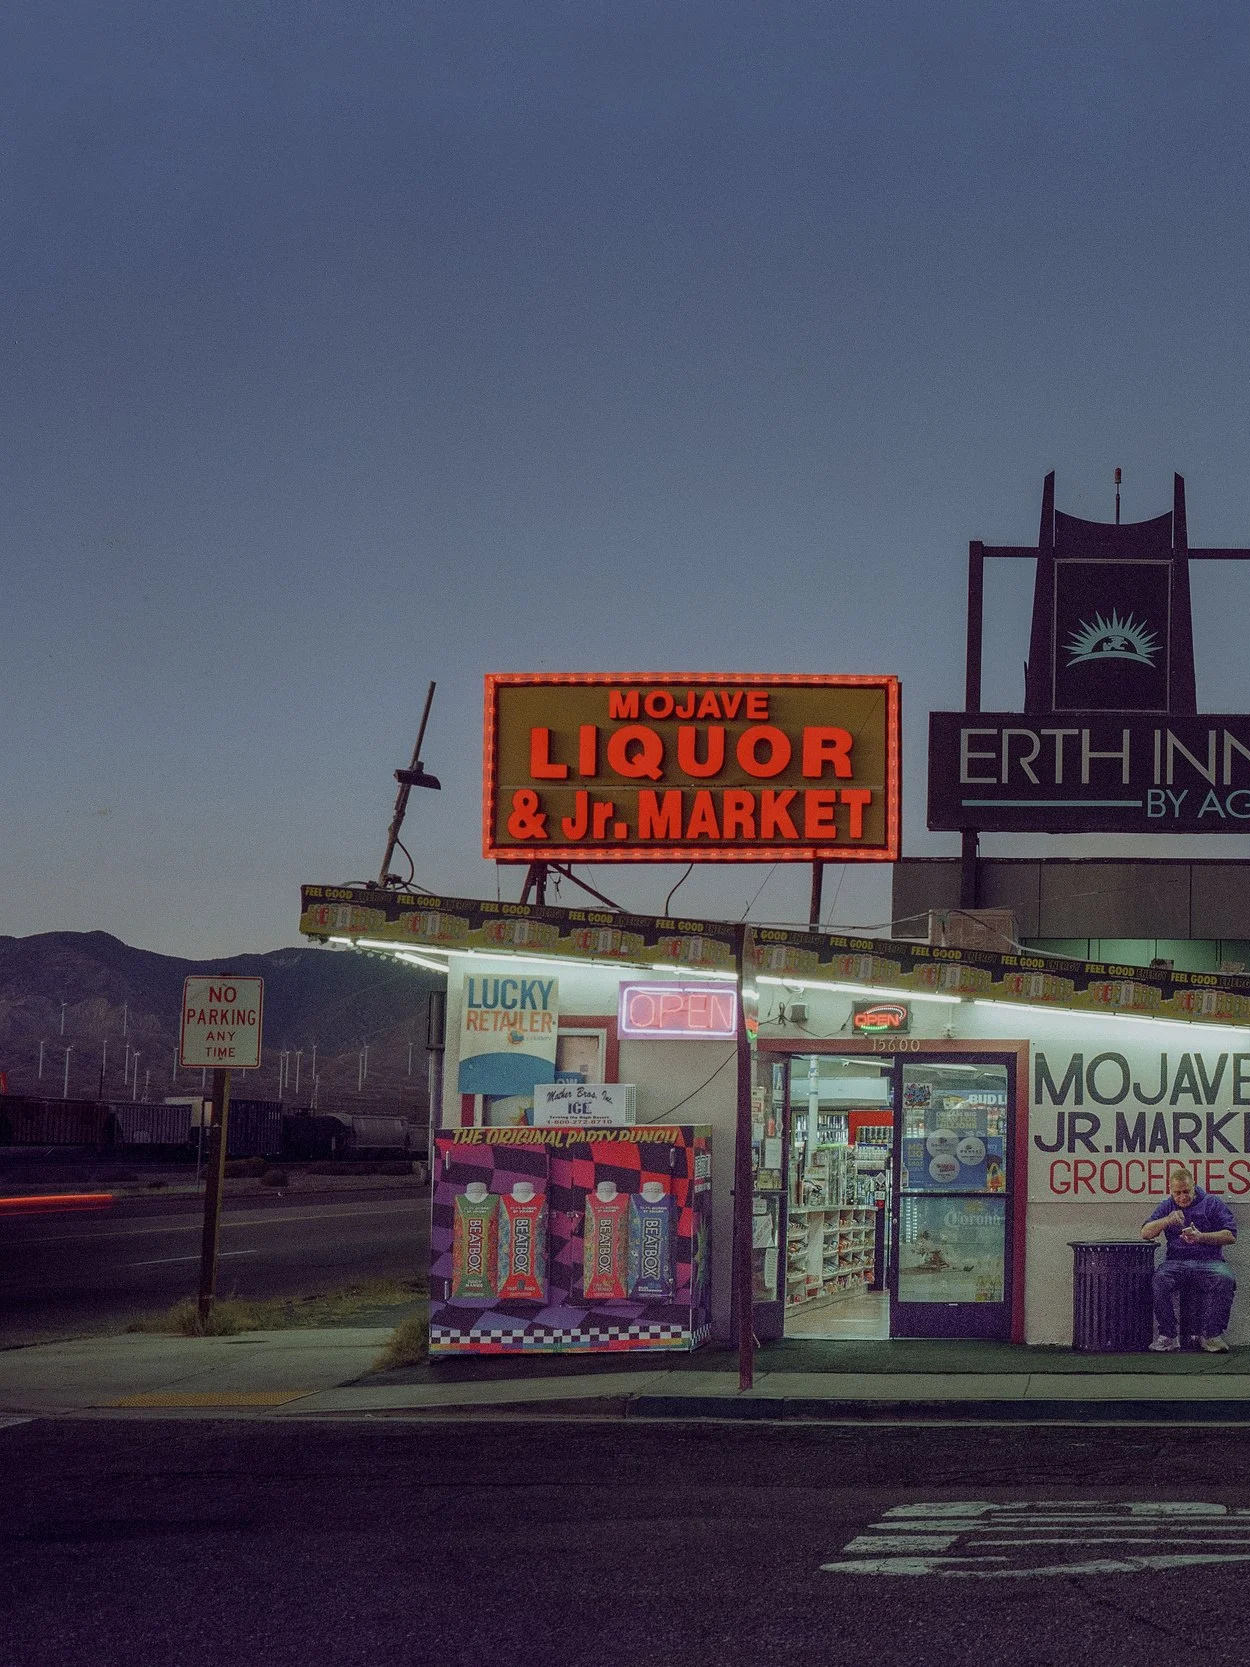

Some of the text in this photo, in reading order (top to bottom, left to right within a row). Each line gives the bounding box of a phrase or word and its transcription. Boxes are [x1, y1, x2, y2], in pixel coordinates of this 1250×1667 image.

[609, 690, 769, 719] MOJAVE
[530, 724, 853, 780] LIQUOR
[959, 728, 1130, 784] ERTH
[1147, 789, 1188, 818] BY
[506, 788, 871, 840] & Jr. MARKET
[305, 887, 323, 897] FEEL
[325, 889, 353, 900] GOOD
[397, 894, 415, 905] FEEL
[417, 897, 441, 907] GOOD
[480, 903, 499, 913] FEEL
[502, 905, 530, 915] GOOD
[569, 911, 585, 921] FEEL
[588, 913, 613, 923] GOOD
[656, 919, 675, 929] FEEL
[678, 921, 704, 932] GOOD
[761, 930, 788, 941] GOOD
[830, 937, 848, 947] FEEL
[850, 939, 873, 950] GOOD
[911, 946, 930, 956] FEEL
[932, 948, 962, 959] GOOD
[1001, 955, 1018, 965] FEEL
[1020, 957, 1044, 968] GOOD
[1085, 964, 1105, 974] FEEL
[1108, 966, 1135, 976] GOOD
[1171, 972, 1188, 983] FEEL
[1190, 974, 1217, 985] GOOD
[209, 986, 236, 1003] NO
[467, 978, 554, 1010] LUCKY
[187, 1009, 256, 1026] PARKING
[629, 994, 733, 1028] OPEN
[466, 1010, 552, 1032] RETAILER
[854, 1013, 900, 1027] OPEN
[205, 1031, 236, 1041] ANY
[205, 1047, 236, 1058] TIME
[873, 1039, 920, 1052] 15600
[969, 1094, 997, 1105] BUD
[568, 1102, 592, 1115] ICE
[452, 1129, 679, 1148] THE ORIGINAL PARTY PUNCH
[944, 1210, 1001, 1228] Corona
[467, 1217, 483, 1274] BEATBOX
[513, 1217, 530, 1275] BEATBOX
[598, 1217, 614, 1274] BEATBOX
[642, 1217, 662, 1279] BEATBOX
